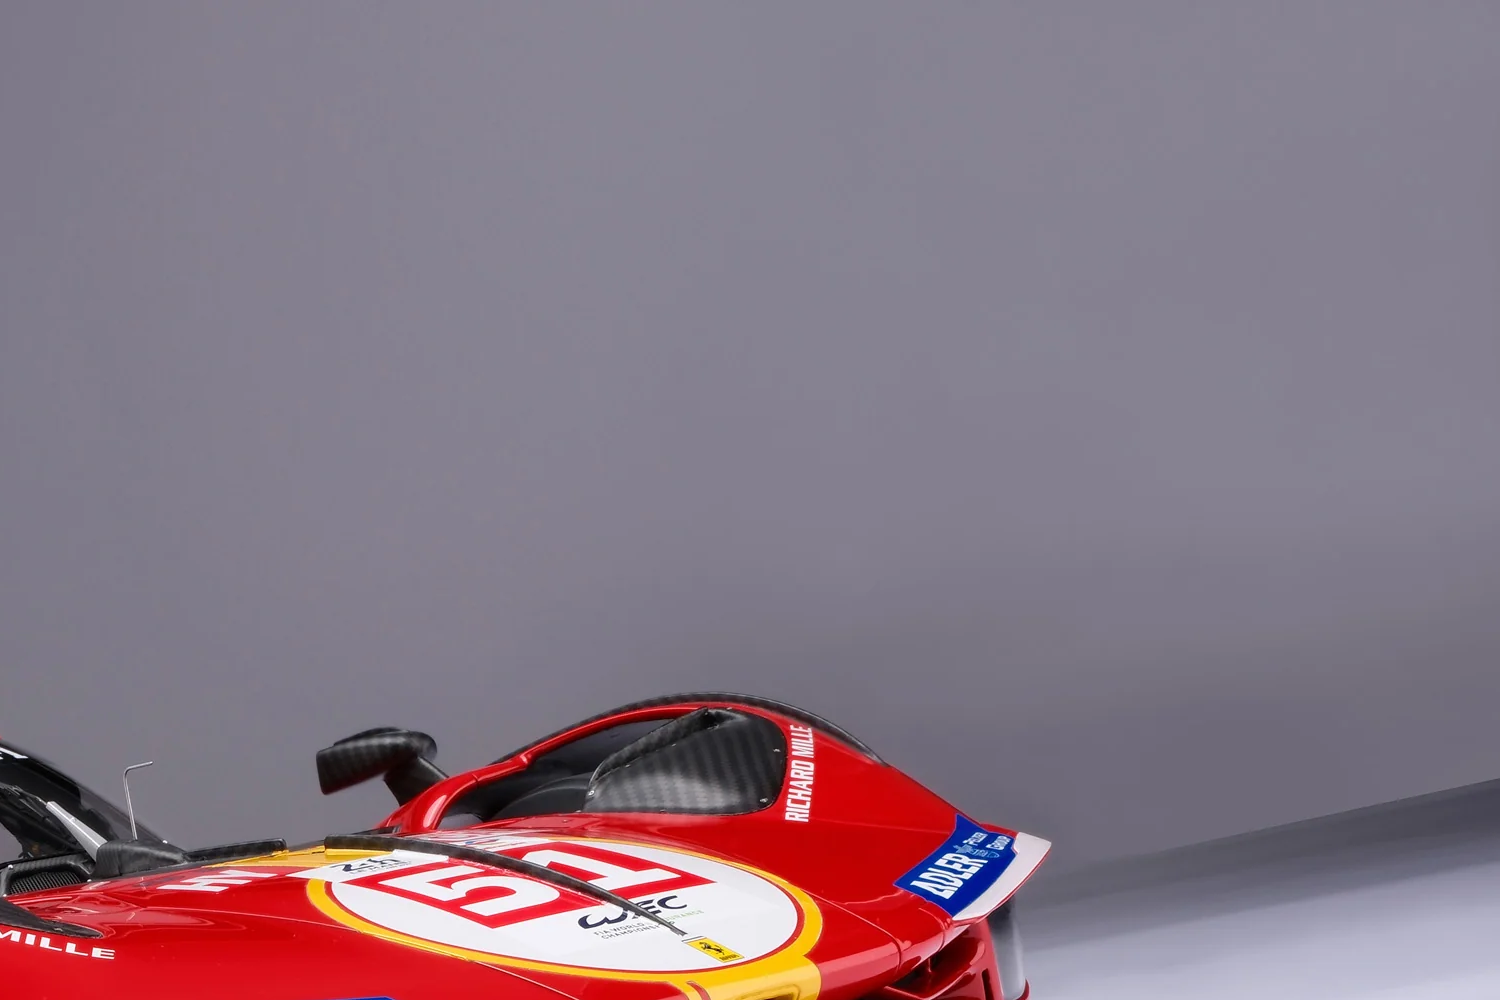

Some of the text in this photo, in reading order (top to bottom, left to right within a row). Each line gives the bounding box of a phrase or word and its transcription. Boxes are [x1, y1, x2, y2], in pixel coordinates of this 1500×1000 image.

[785, 725, 814, 822] RICHARD MILLE
[372, 846, 690, 918] 51
[910, 853, 988, 899] ADLER
[578, 895, 688, 930] WEC
[601, 920, 676, 940] CHAMPIONSHP
